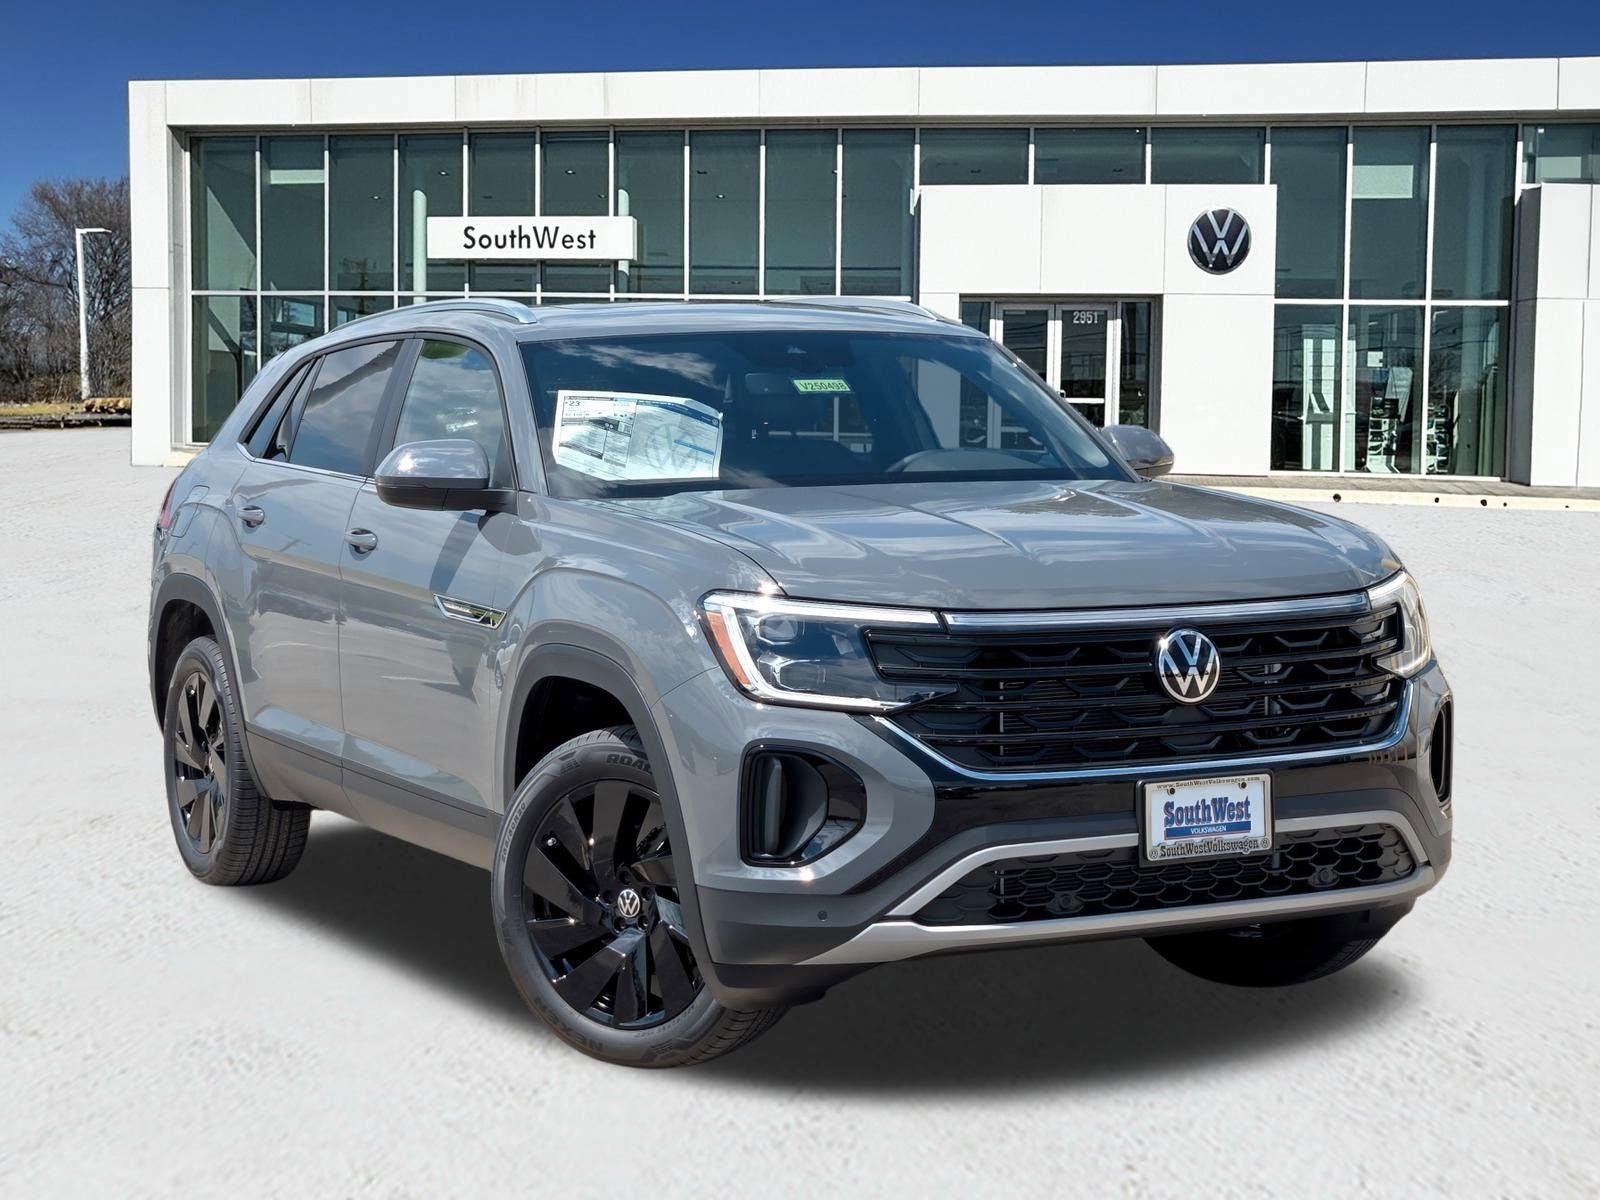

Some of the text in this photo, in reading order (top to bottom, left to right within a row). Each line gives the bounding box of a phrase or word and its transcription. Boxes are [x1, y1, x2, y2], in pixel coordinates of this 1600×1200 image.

[463, 225, 597, 249] SouthWest
[1189, 208, 1250, 270] VW
[1072, 311, 1098, 324] 2951
[1159, 629, 1219, 700] VW
[1163, 796, 1251, 827] SouthWest
[1190, 825, 1227, 834] VOLKSWAGEN
[618, 889, 640, 917] VW
